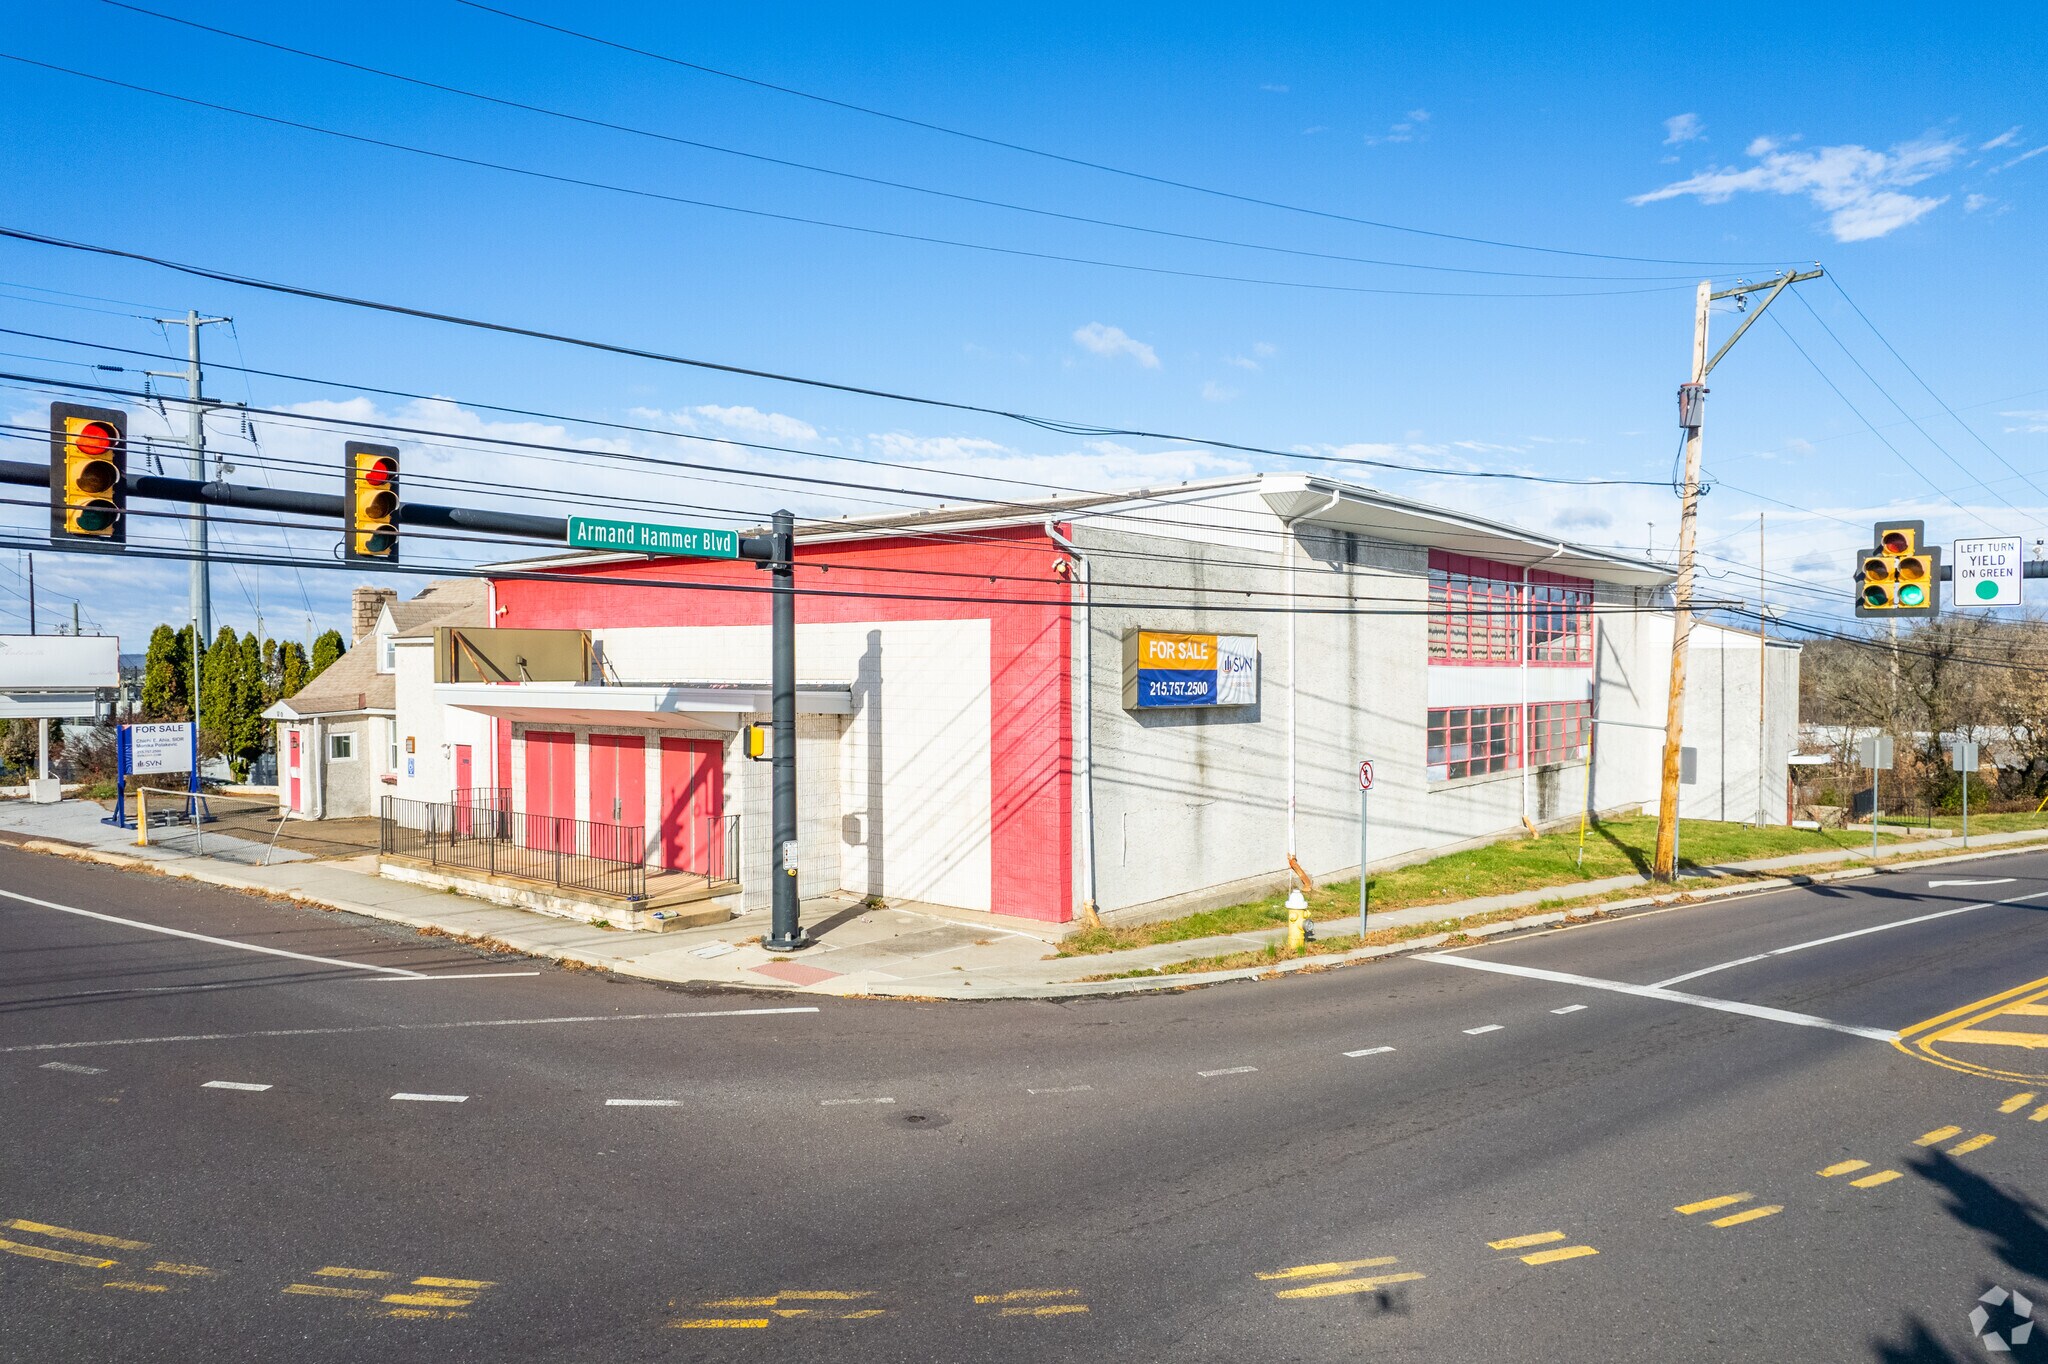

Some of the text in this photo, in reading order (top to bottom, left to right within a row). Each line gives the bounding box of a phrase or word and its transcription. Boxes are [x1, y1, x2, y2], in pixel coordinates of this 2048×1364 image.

[577, 521, 731, 552] Armand Hammer Blvd
[1960, 543, 2014, 553] LEFT TURN
[1970, 555, 2006, 566] YIELD
[1961, 568, 2013, 578] ON GREEN
[1149, 640, 1209, 660] FOR SALE
[1233, 657, 1253, 673] SVN
[1150, 681, 1209, 696] 215.757.2500
